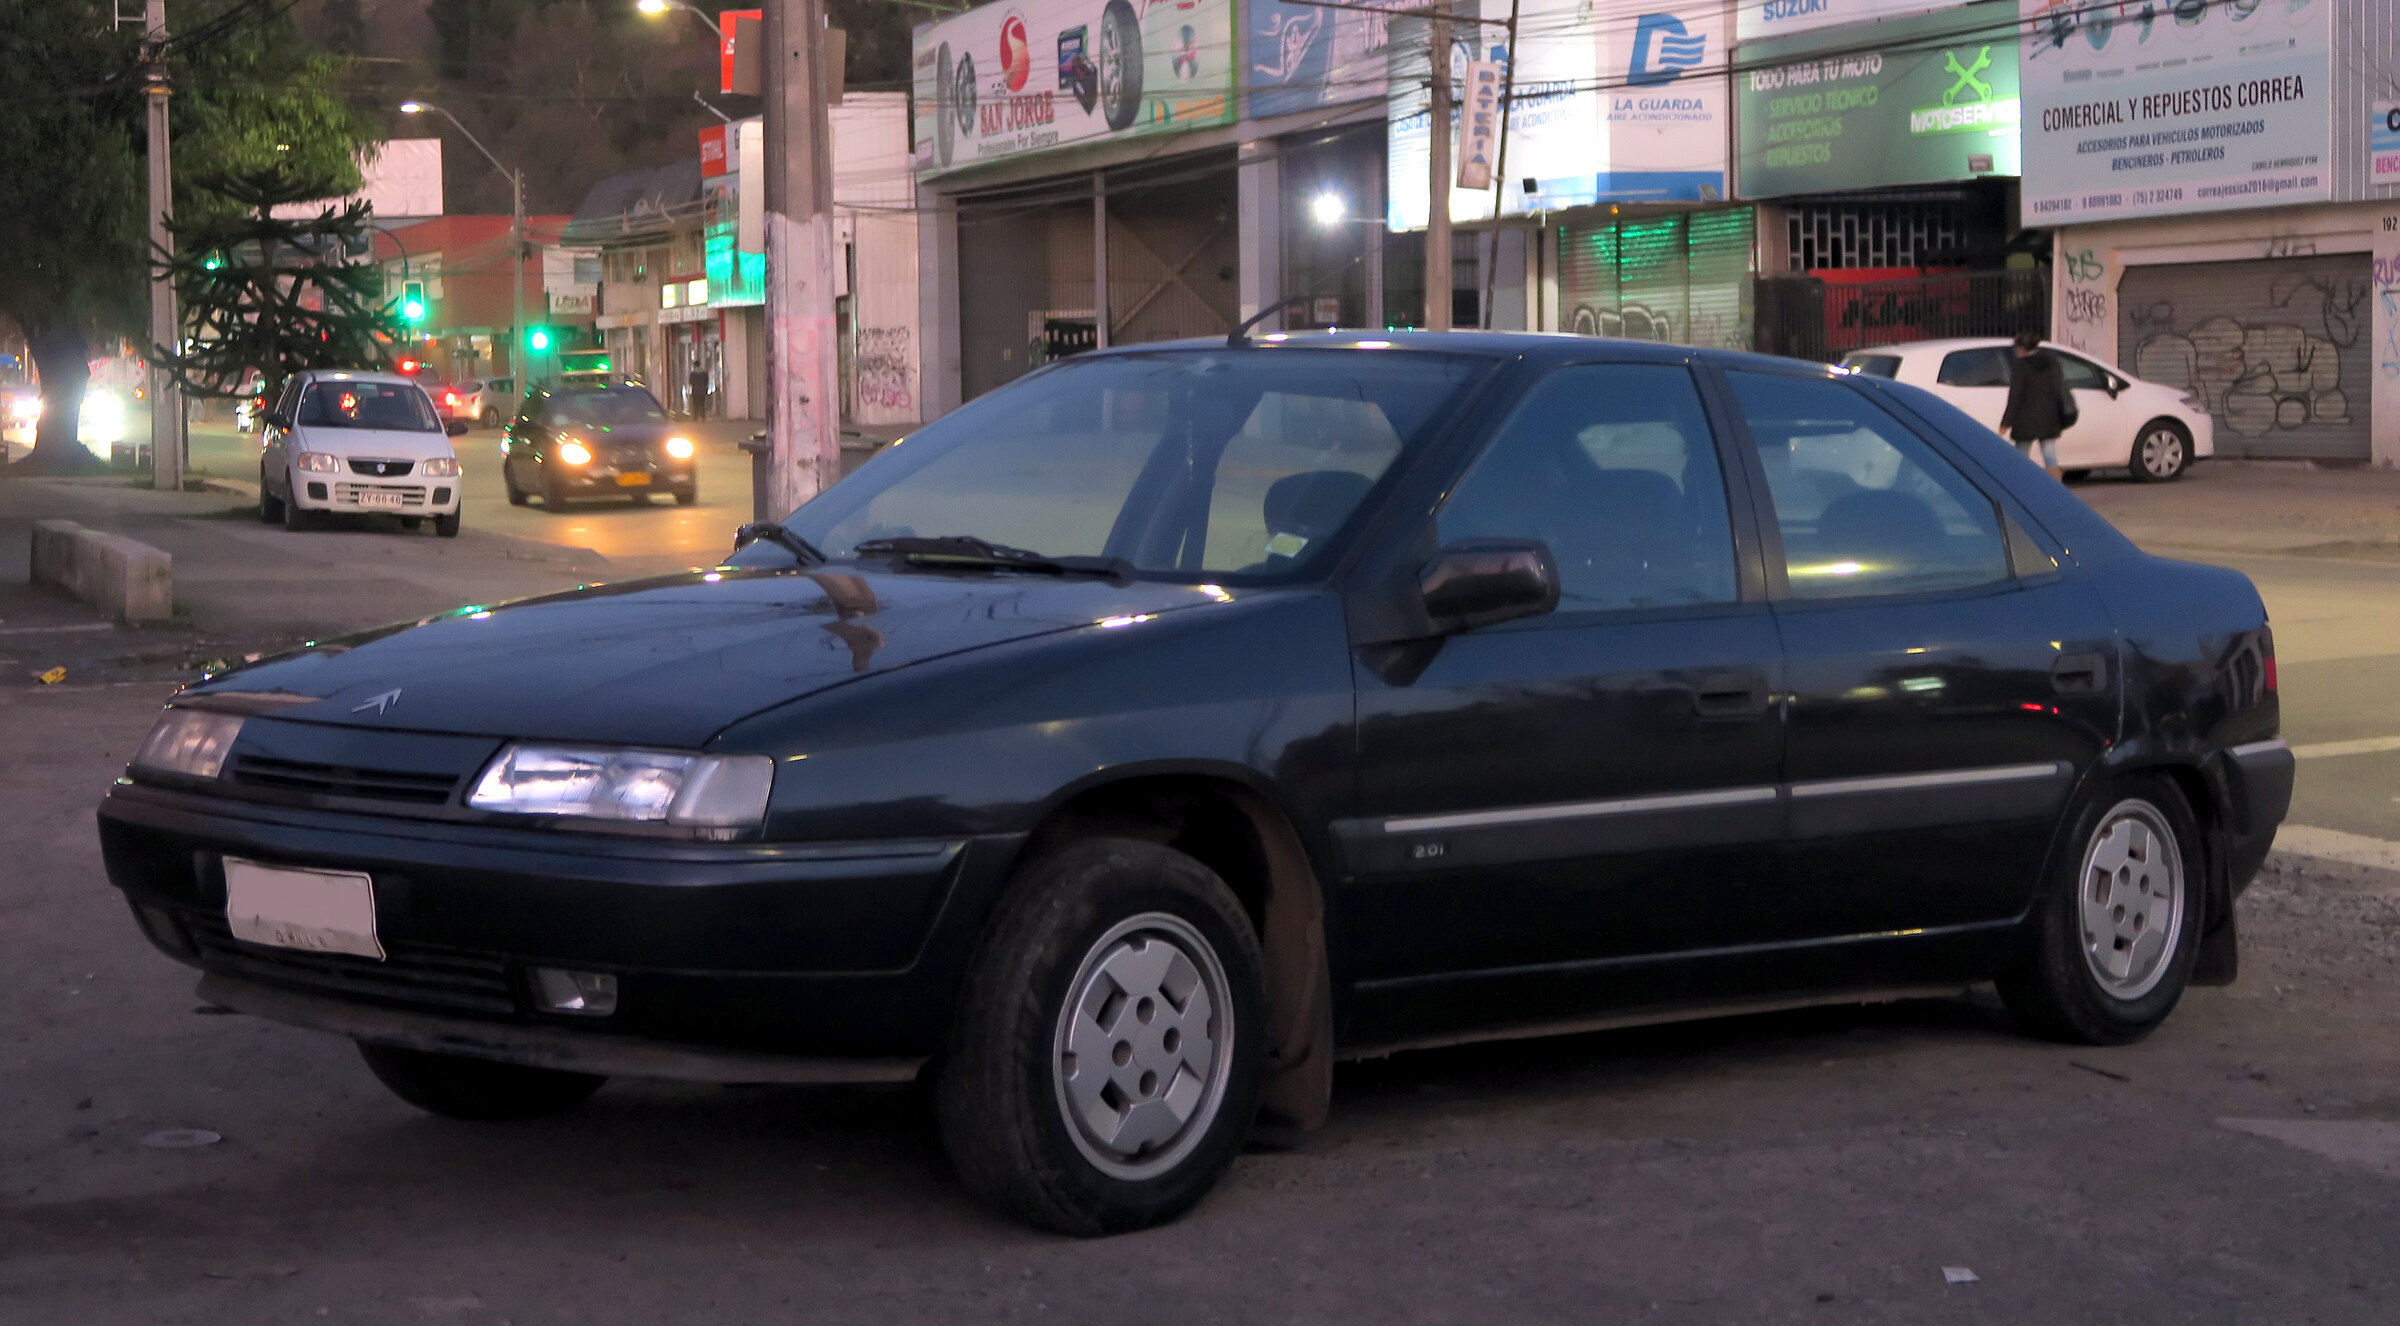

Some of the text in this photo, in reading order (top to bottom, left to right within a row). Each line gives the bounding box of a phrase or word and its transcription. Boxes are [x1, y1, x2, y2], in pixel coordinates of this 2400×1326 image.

[1764, 0, 1827, 21] SUZUKI
[1750, 54, 1883, 91] TODO PARA TU MOTO
[1528, 79, 1576, 108] GUARDA
[1614, 98, 1704, 111] LA GUARDA
[1770, 93, 1822, 119] SERVICIO
[2043, 75, 2304, 132] COMERCIAL Y REPUESTOS CORREA
[980, 91, 1055, 136] SAN JORGE
[1471, 70, 1495, 164] BATERIA
[1607, 112, 1713, 121] AIRE ACONDICIONADO
[2076, 119, 2265, 154] ACCESORIOS PARA VEHICULOS MOTORIZADOS
[2112, 153, 2165, 171] BENCINEROS
[2170, 146, 2225, 165] PETROLEROS
